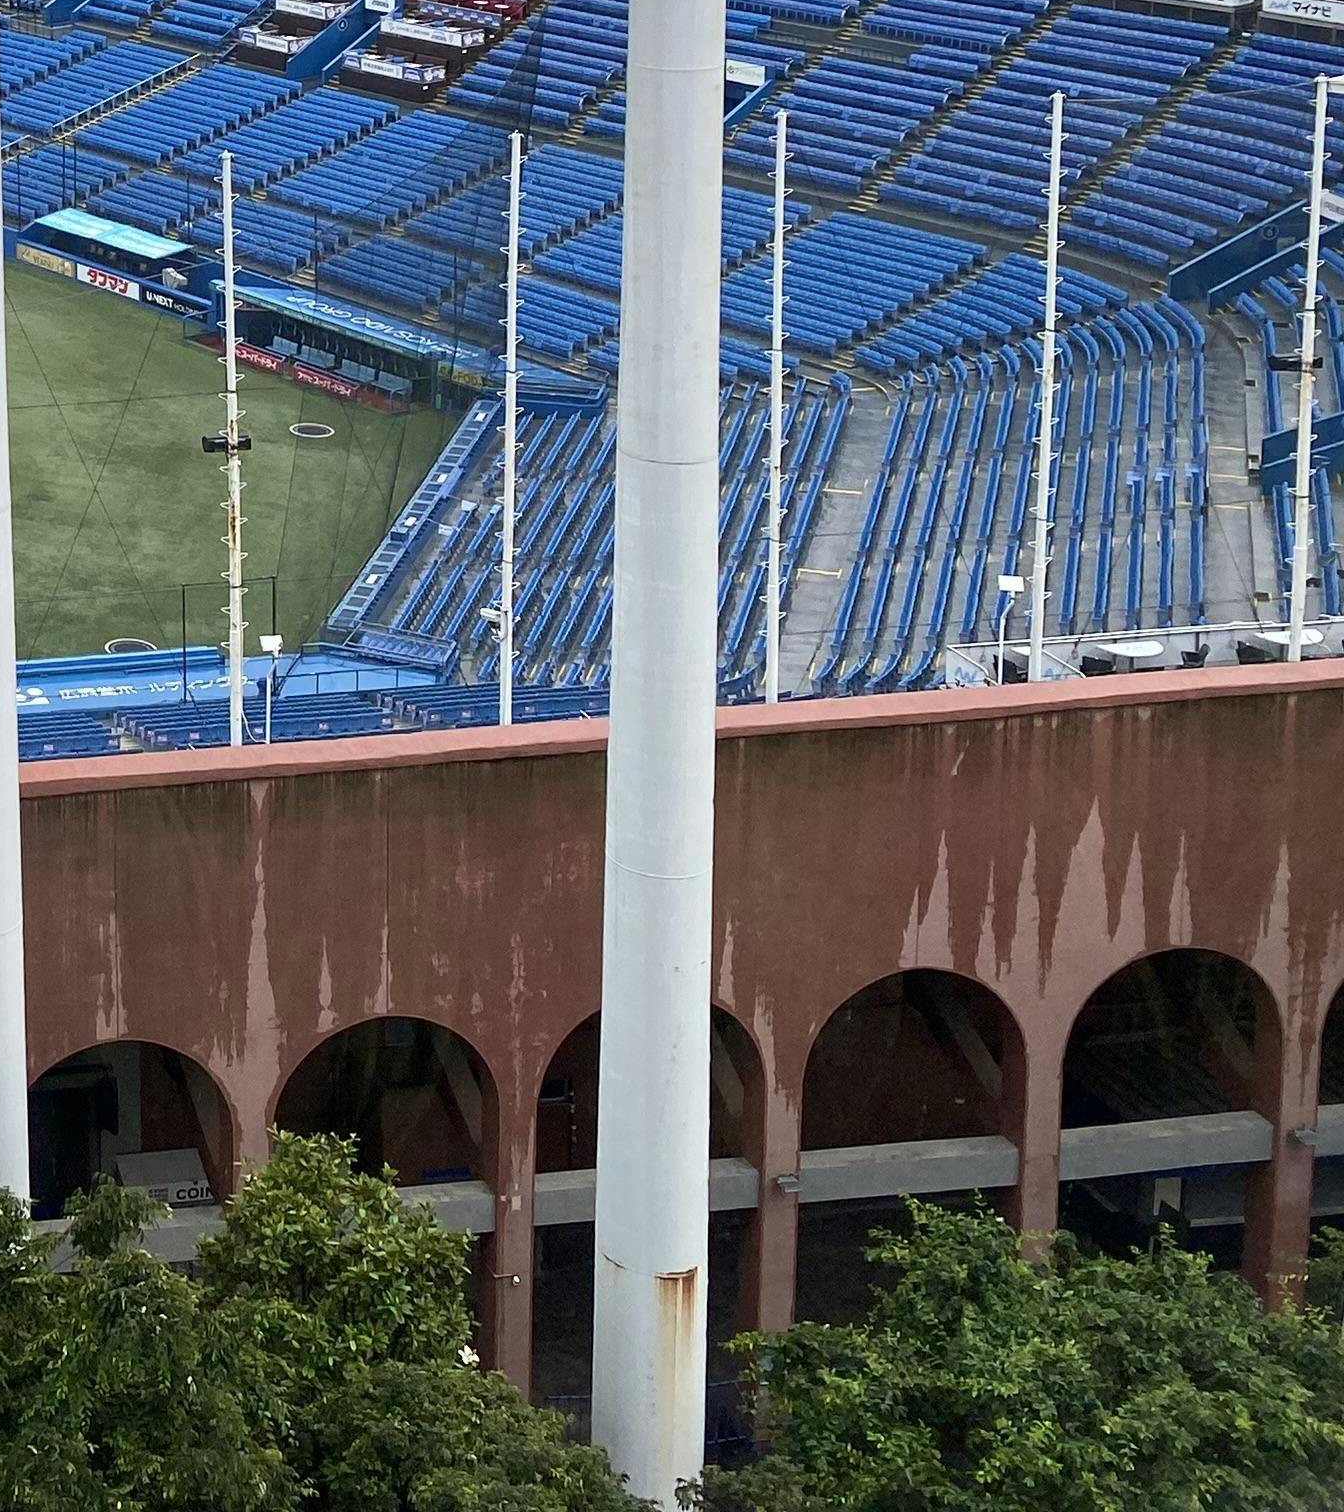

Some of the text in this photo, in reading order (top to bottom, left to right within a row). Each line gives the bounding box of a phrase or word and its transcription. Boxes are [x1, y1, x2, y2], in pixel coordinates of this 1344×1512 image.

[1292, 1, 1332, 18] マイナビ
[86, 268, 129, 294] タフマン
